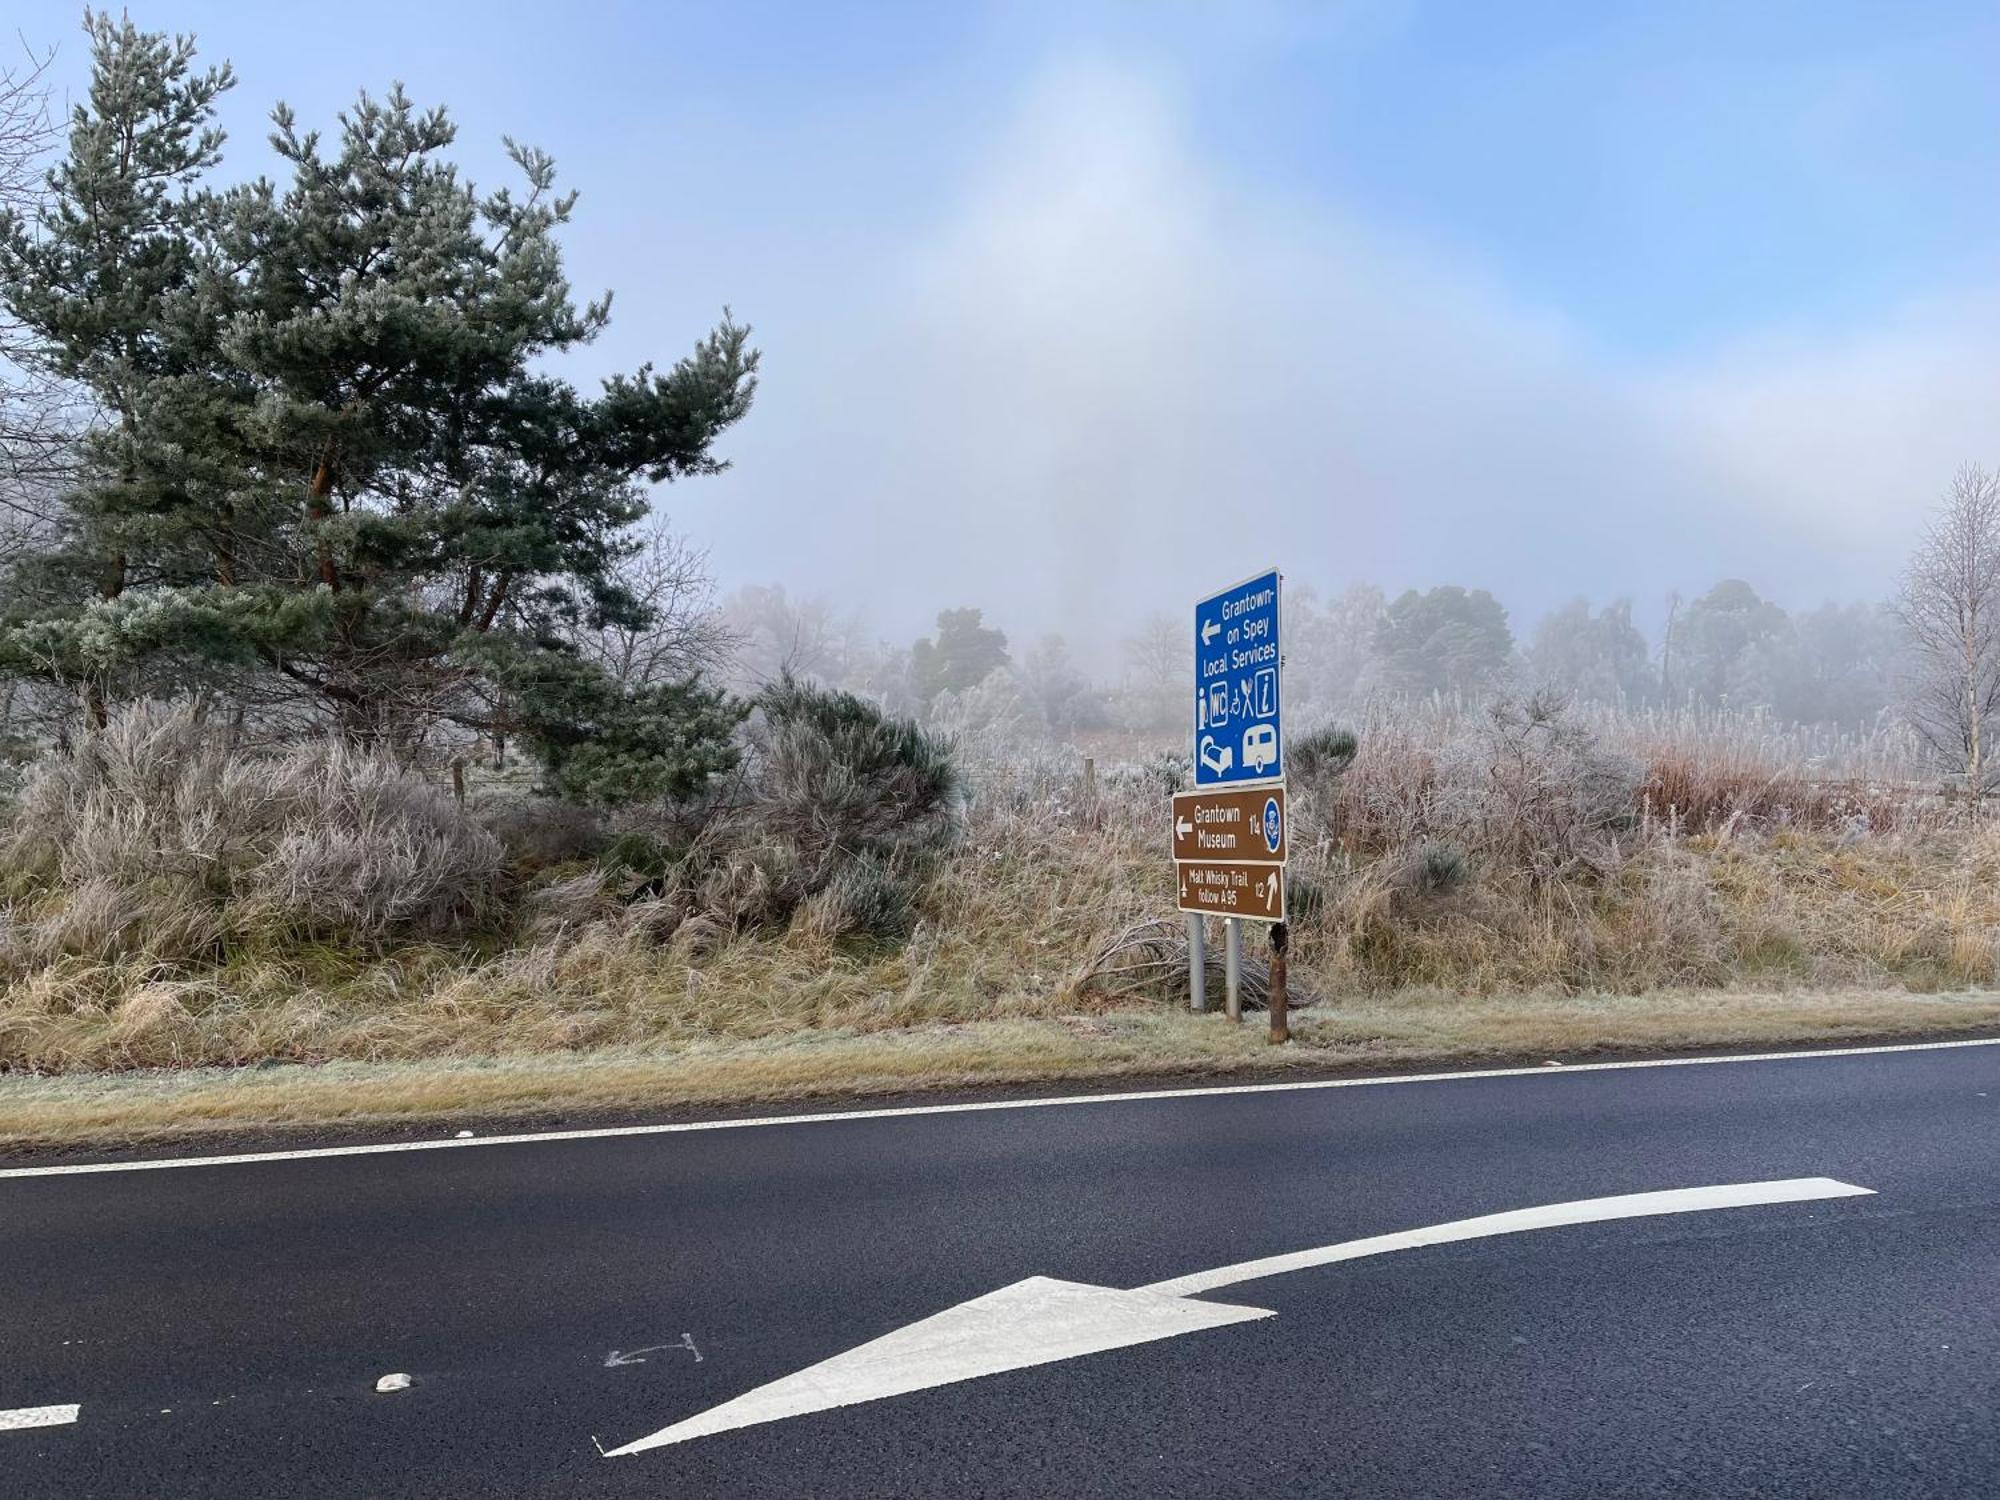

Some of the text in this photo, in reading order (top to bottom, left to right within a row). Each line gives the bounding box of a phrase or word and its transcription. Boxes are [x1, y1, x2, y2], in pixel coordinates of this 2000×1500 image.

[1222, 589, 1274, 620] Grantown-
[1227, 617, 1269, 645] on Spey
[1203, 642, 1275, 677] Local Services
[1211, 692, 1226, 717] WC
[1194, 804, 1240, 823] Grantown
[1198, 829, 1236, 848] Museum
[1189, 869, 1248, 889] Malt Whisky Trail
[1198, 888, 1219, 904] follow
